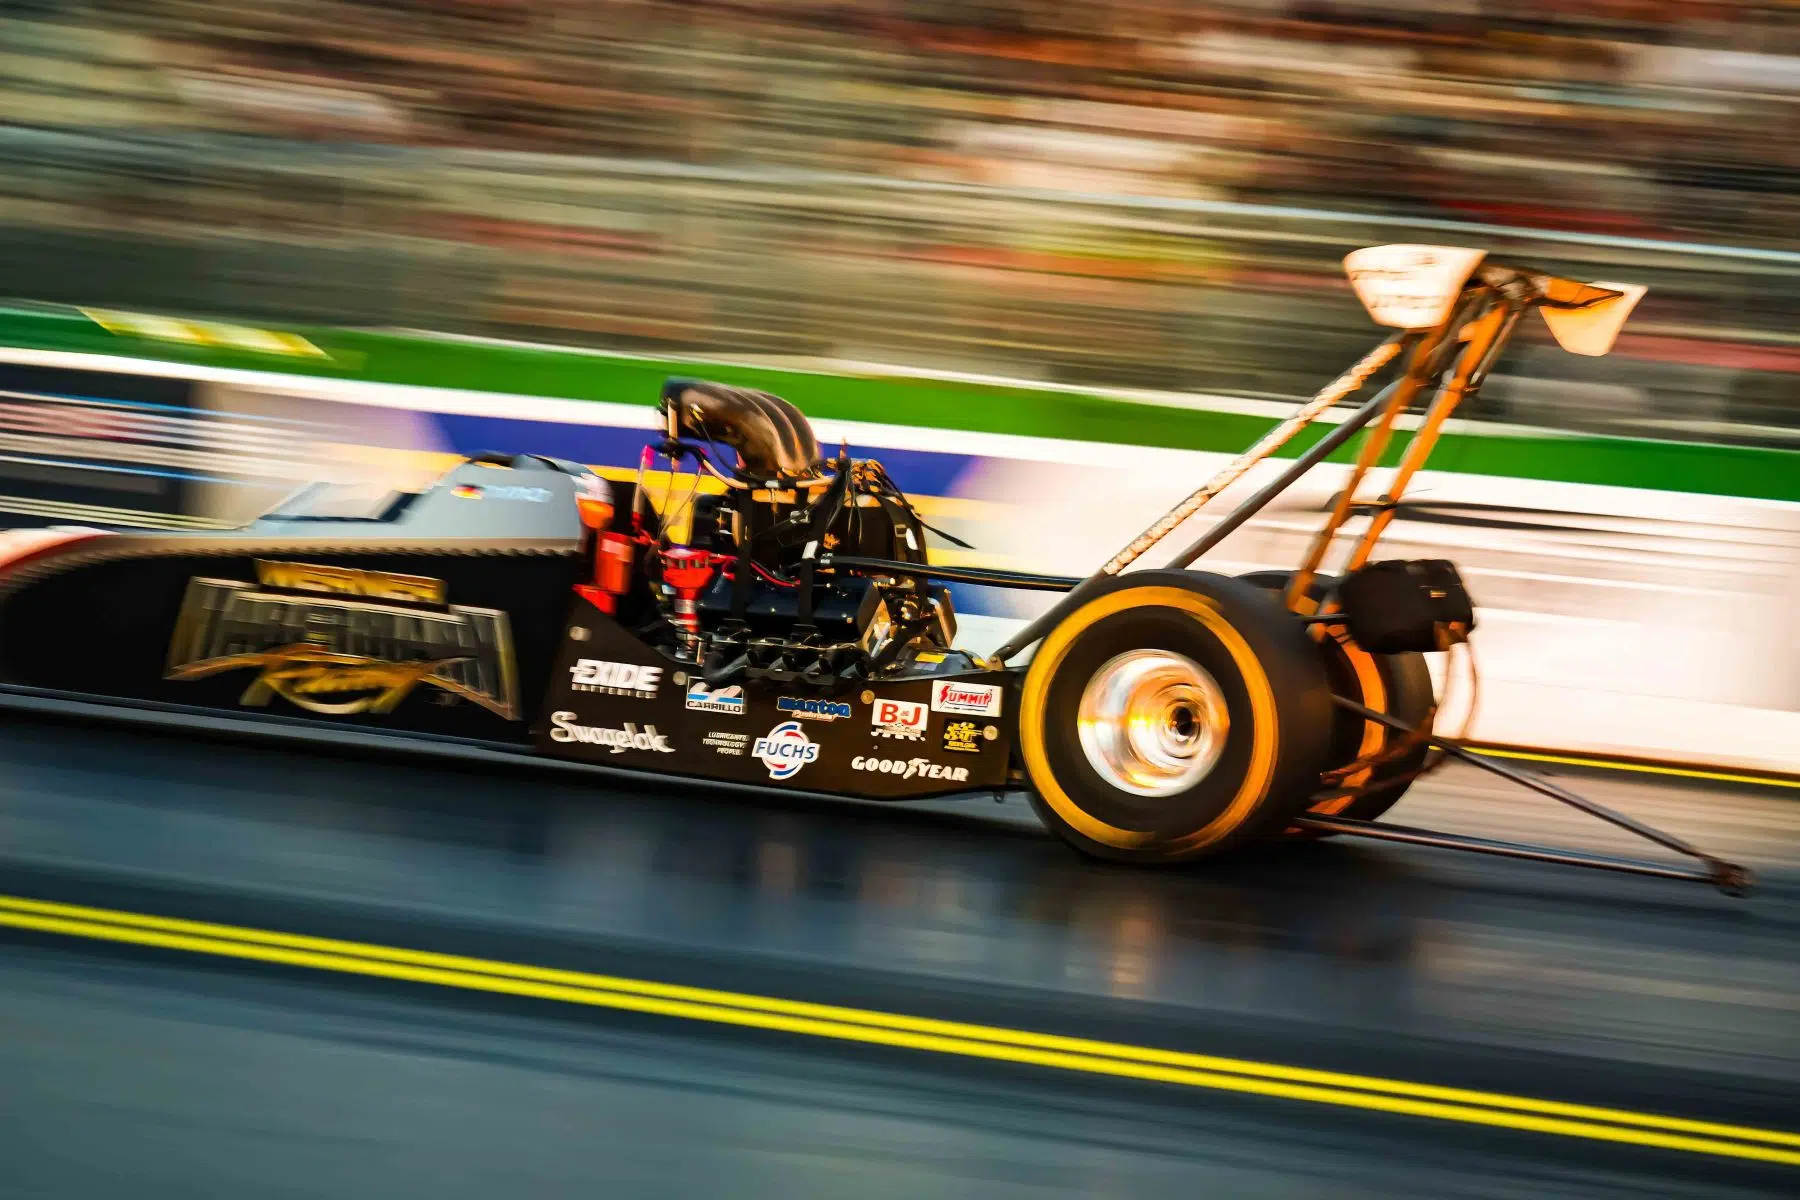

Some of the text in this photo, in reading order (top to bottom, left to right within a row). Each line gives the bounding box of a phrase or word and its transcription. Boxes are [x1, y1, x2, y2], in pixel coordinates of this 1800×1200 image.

[569, 658, 664, 692] EXIDE
[687, 700, 742, 713] CARRILLO
[550, 710, 677, 754] Swagelok
[755, 740, 816, 760] FUCHS
[851, 755, 970, 782] GOODYEAR
